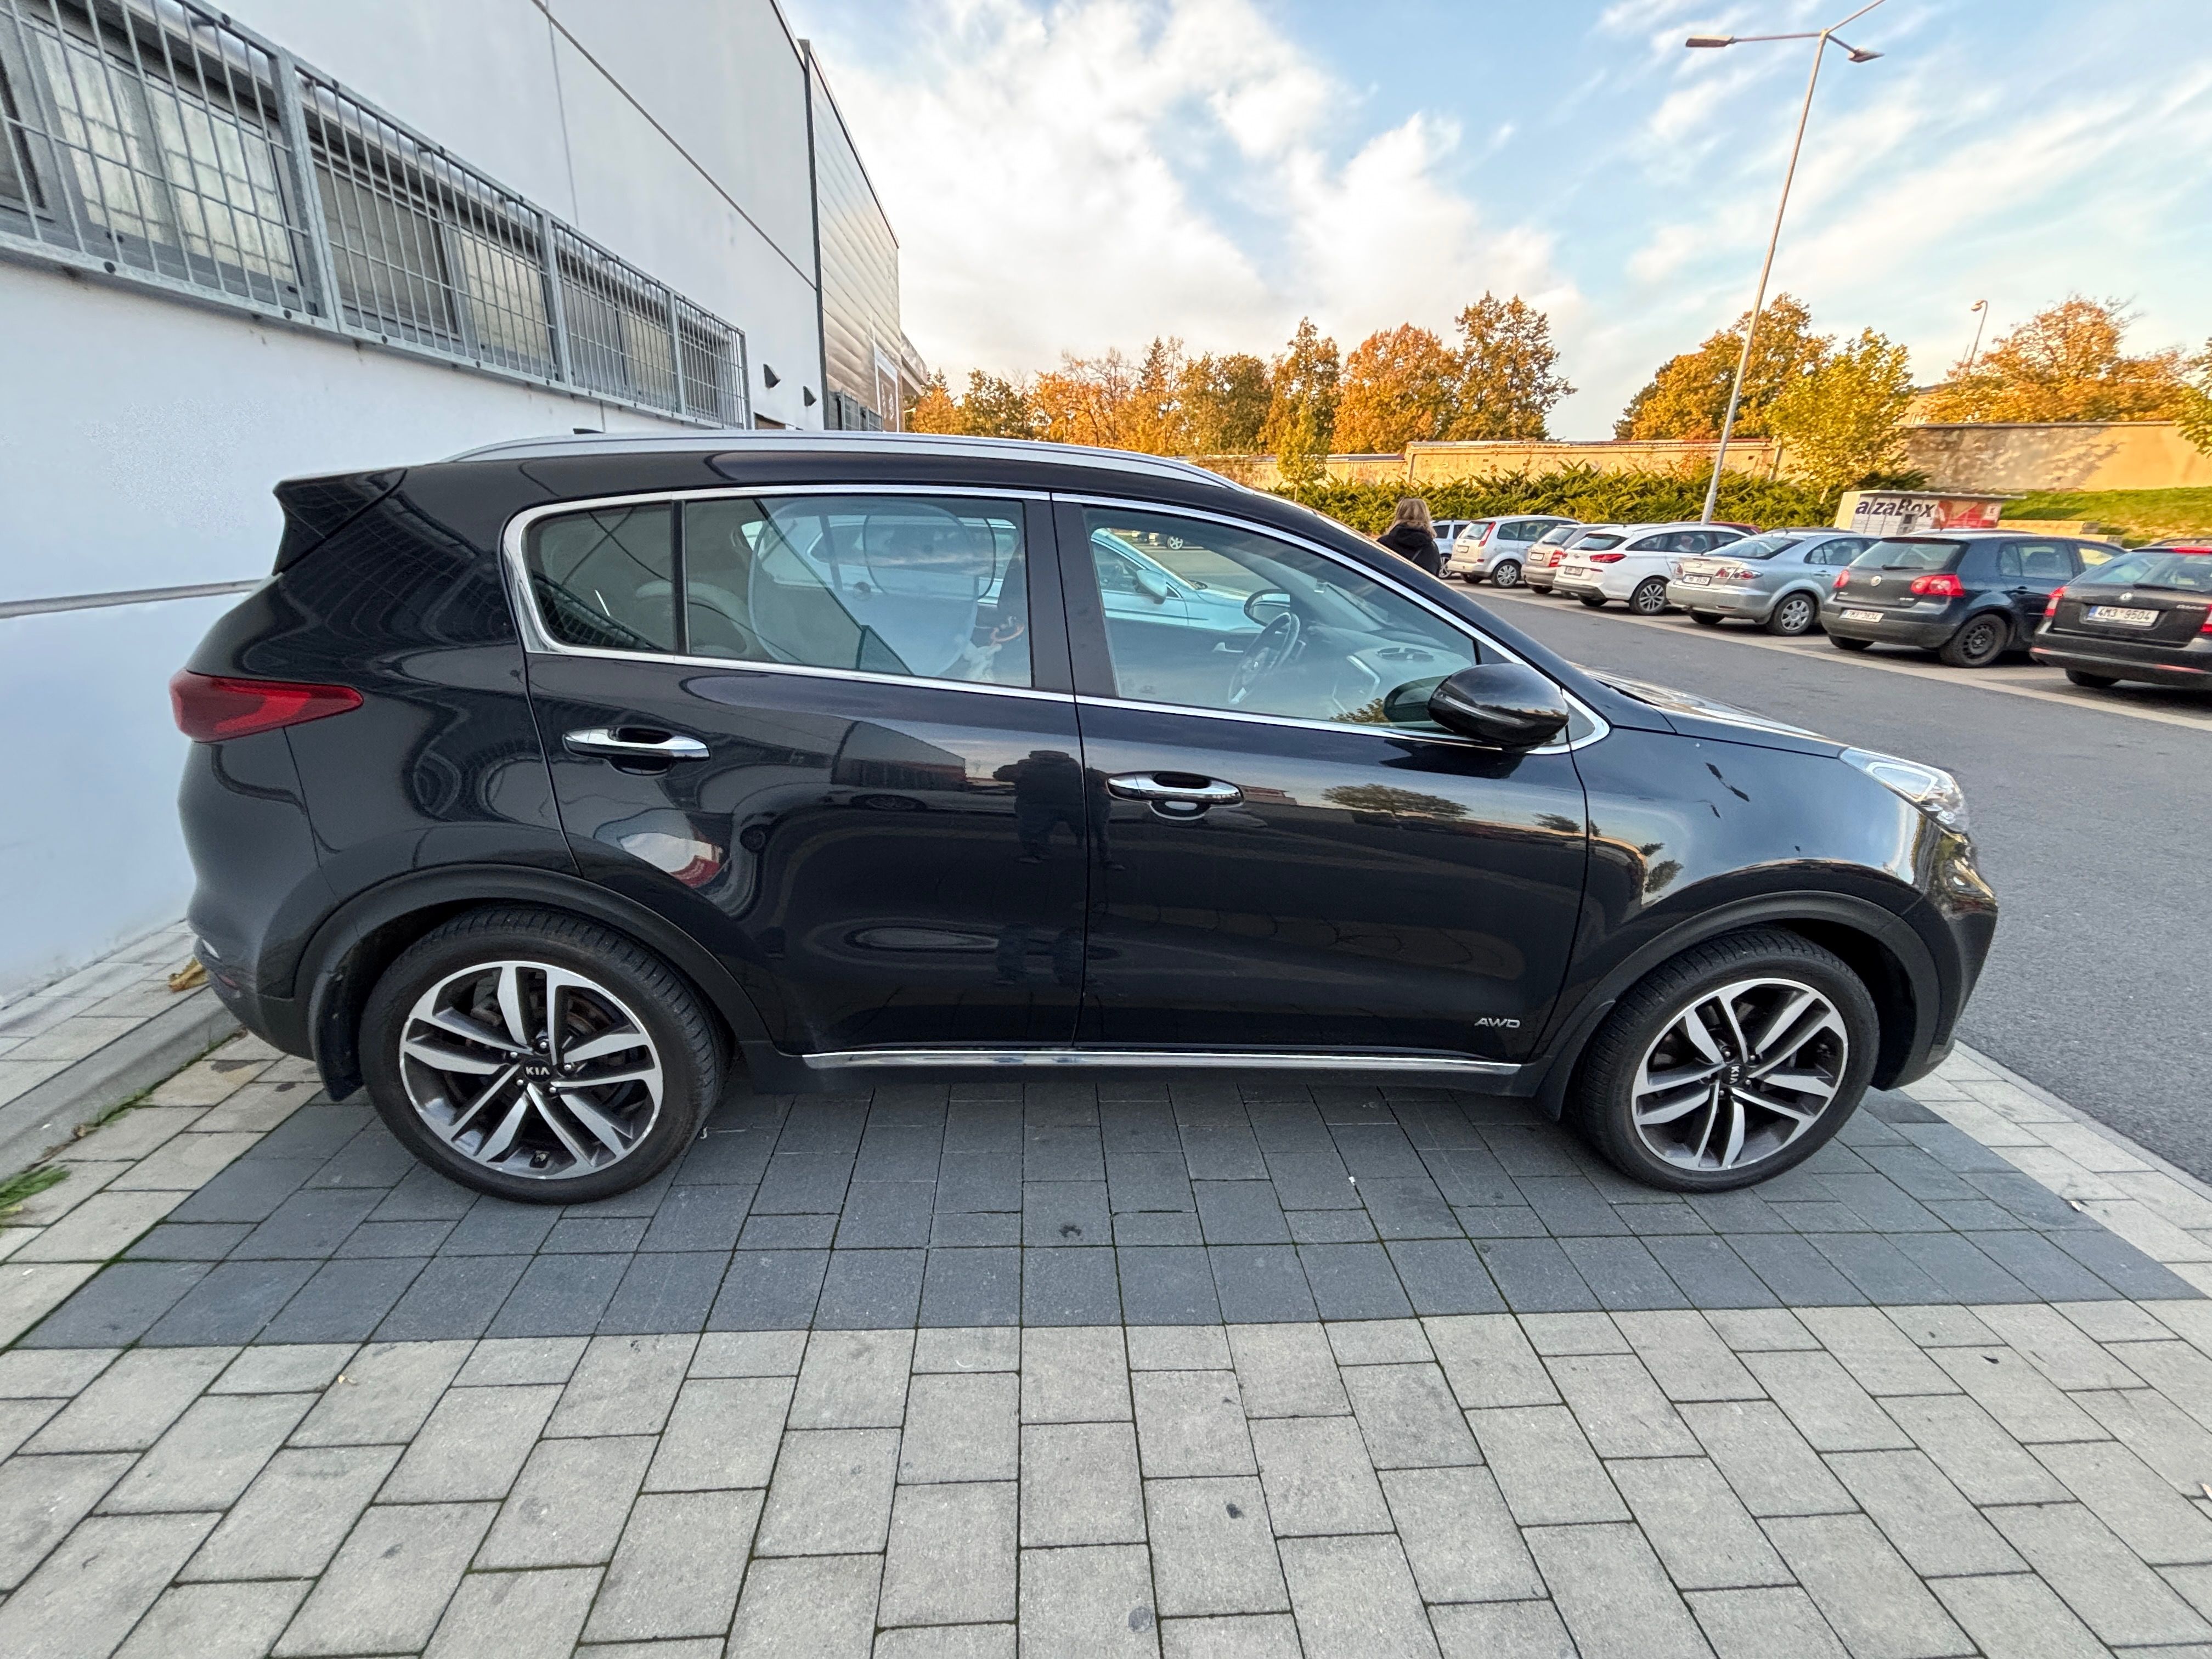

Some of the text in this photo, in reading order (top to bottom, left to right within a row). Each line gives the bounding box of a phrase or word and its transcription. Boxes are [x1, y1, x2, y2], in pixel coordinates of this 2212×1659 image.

[1855, 498, 1938, 518] alzaBox
[1474, 1018, 1521, 1029] AWD
[525, 1066, 550, 1076] KIA
[1729, 1065, 1740, 1084] KIA
